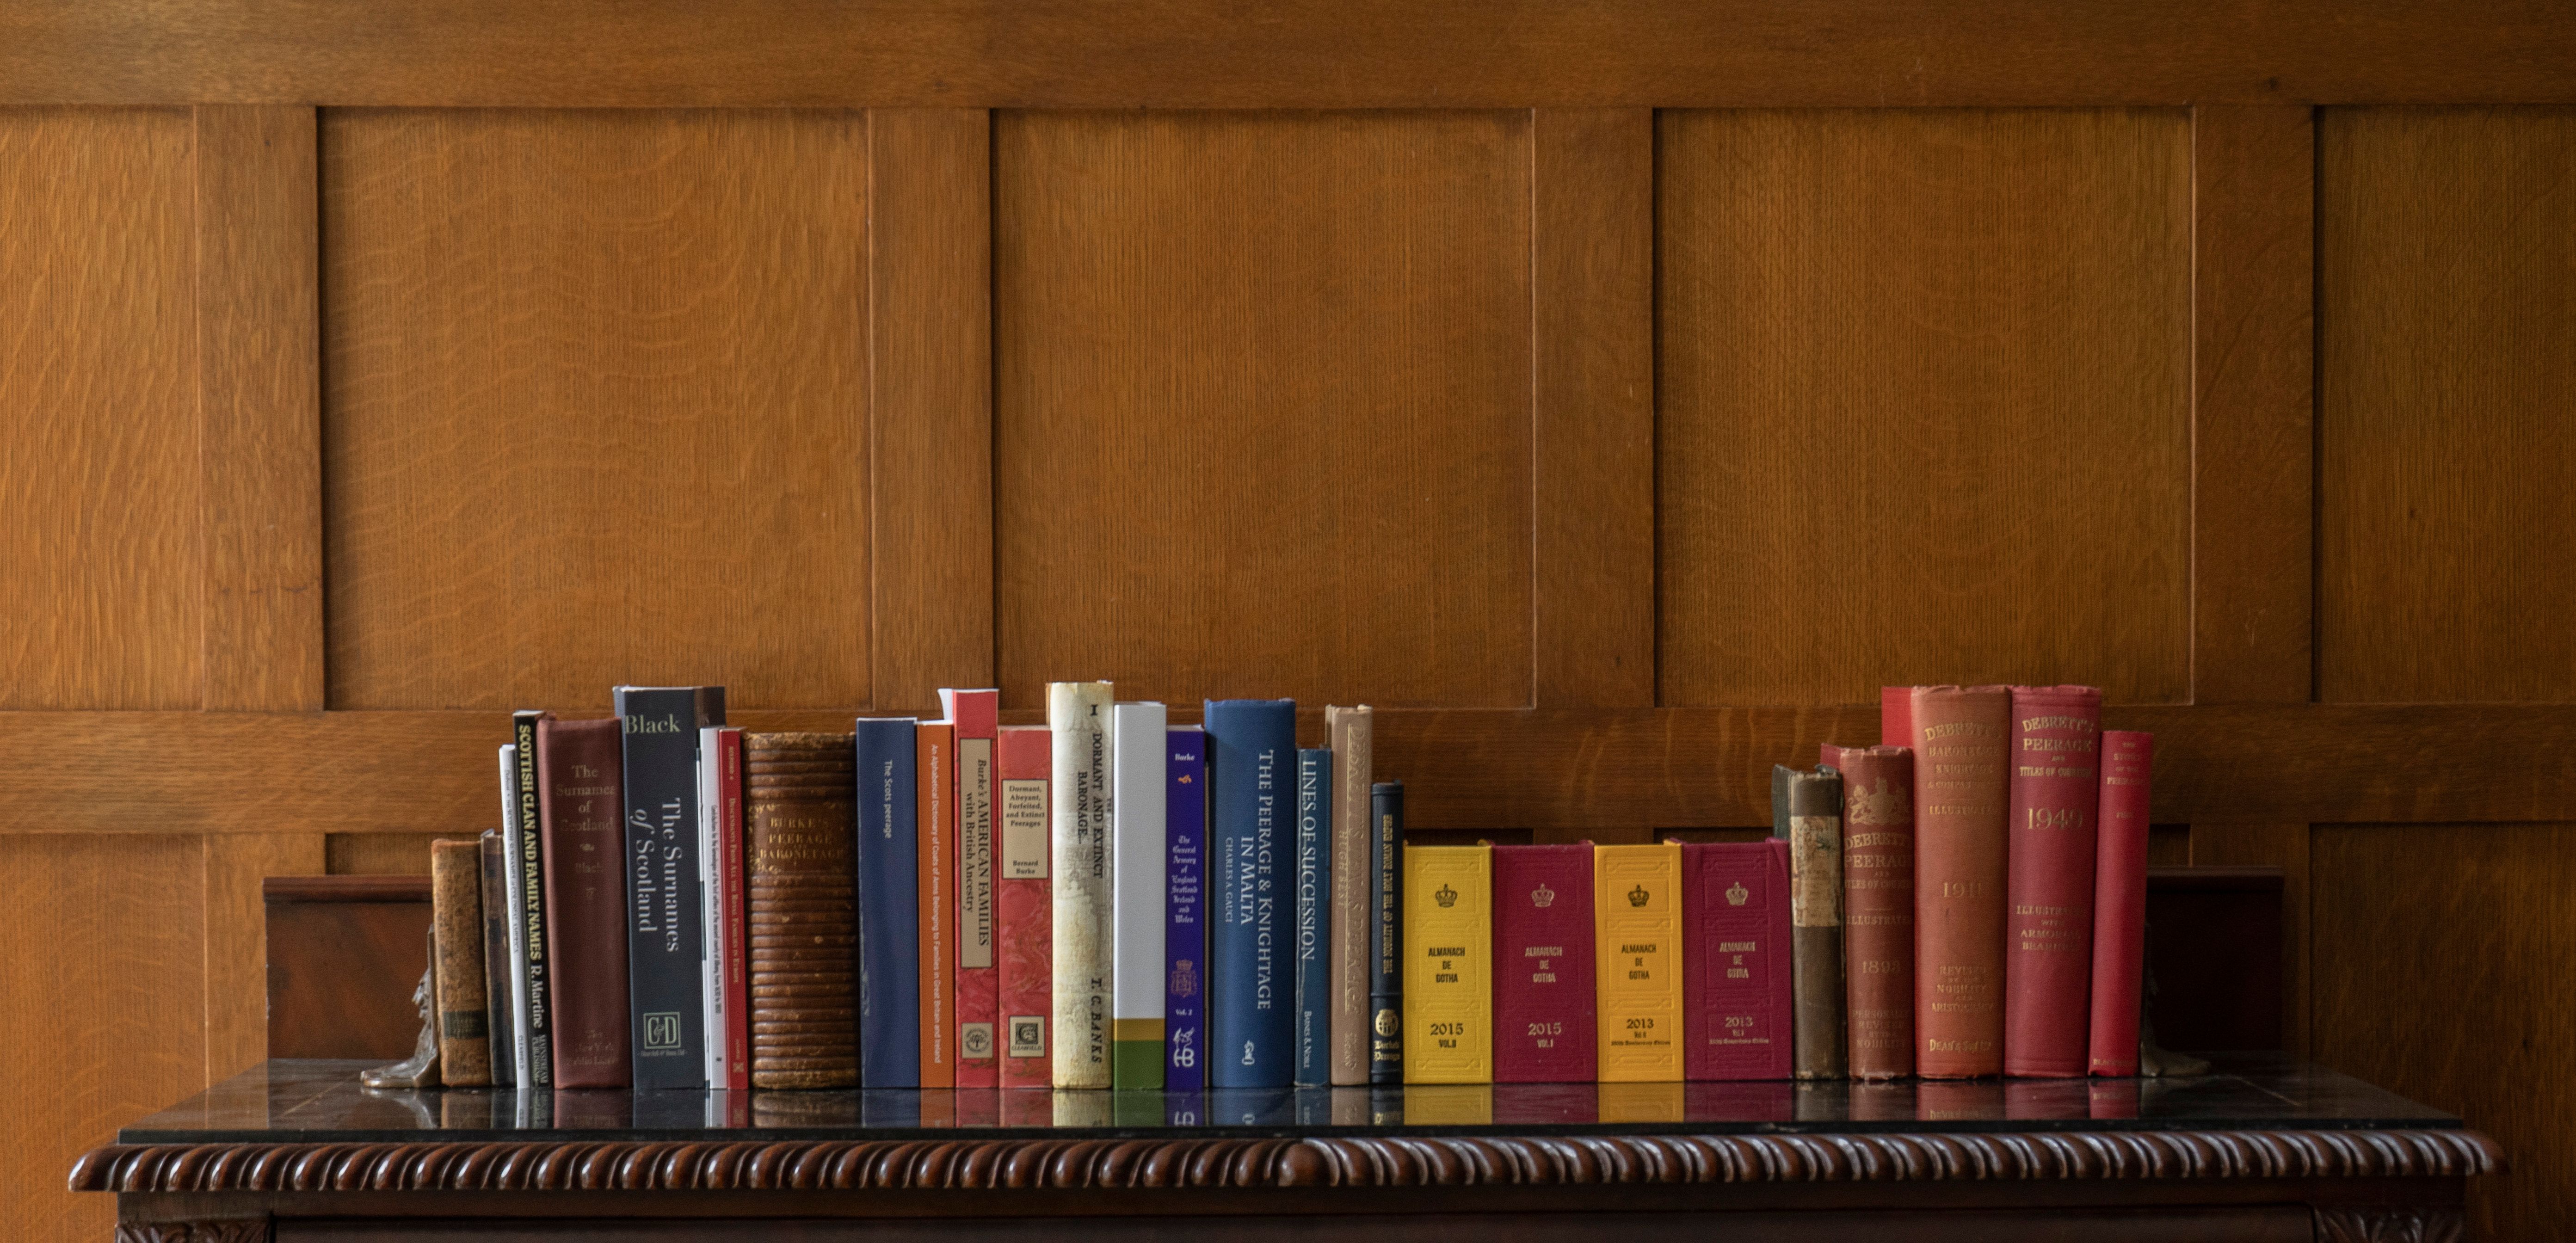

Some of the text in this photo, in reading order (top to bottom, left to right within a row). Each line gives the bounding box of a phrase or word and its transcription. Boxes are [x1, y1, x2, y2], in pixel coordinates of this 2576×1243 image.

[625, 714, 682, 734] Black
[2022, 738, 2092, 752] PEERAGE
[571, 764, 599, 778] The
[883, 759, 893, 839] The Scots peerage
[1092, 733, 1103, 878] DORMANT AND EXTINCT
[578, 800, 592, 813] of
[2027, 807, 2084, 830] 1940
[962, 792, 975, 913] with British Ancestry
[977, 759, 989, 946] Burke's AMERICAN FAMILIES
[1225, 837, 1234, 880] CHARLES
[1300, 761, 1317, 961] LINES OF SUCCESSION
[519, 725, 544, 1029] SCOTTISH CLAN AND FAMILY NAMES R. Martine
[628, 809, 658, 932] of Scotland
[662, 797, 683, 953] The Surnames
[1240, 836, 1256, 926] IN MALTA
[1257, 749, 1274, 1010] THE PEERAGE & KNIGHTAGE
[1225, 892, 1233, 923] GAUCI
[1428, 947, 1466, 957] ALMANACH
[1524, 946, 1563, 957] ALMANACH
[1621, 944, 1657, 954] ALMANACH
[1719, 941, 1756, 953] ALMANACH
[1442, 960, 1452, 970] DE
[1539, 959, 1549, 970] DE
[1436, 973, 1458, 983] GOTHA
[1533, 972, 1557, 983] GOTHA
[1628, 970, 1650, 980] GOTHA
[1726, 967, 1749, 979] GOTHA
[1430, 1022, 1464, 1036] 2015
[1528, 1022, 1562, 1036] 2015
[1626, 1018, 1655, 1029] 2013
[1725, 1016, 1754, 1028] 2013
[1091, 1011, 1103, 1063] BANKS
